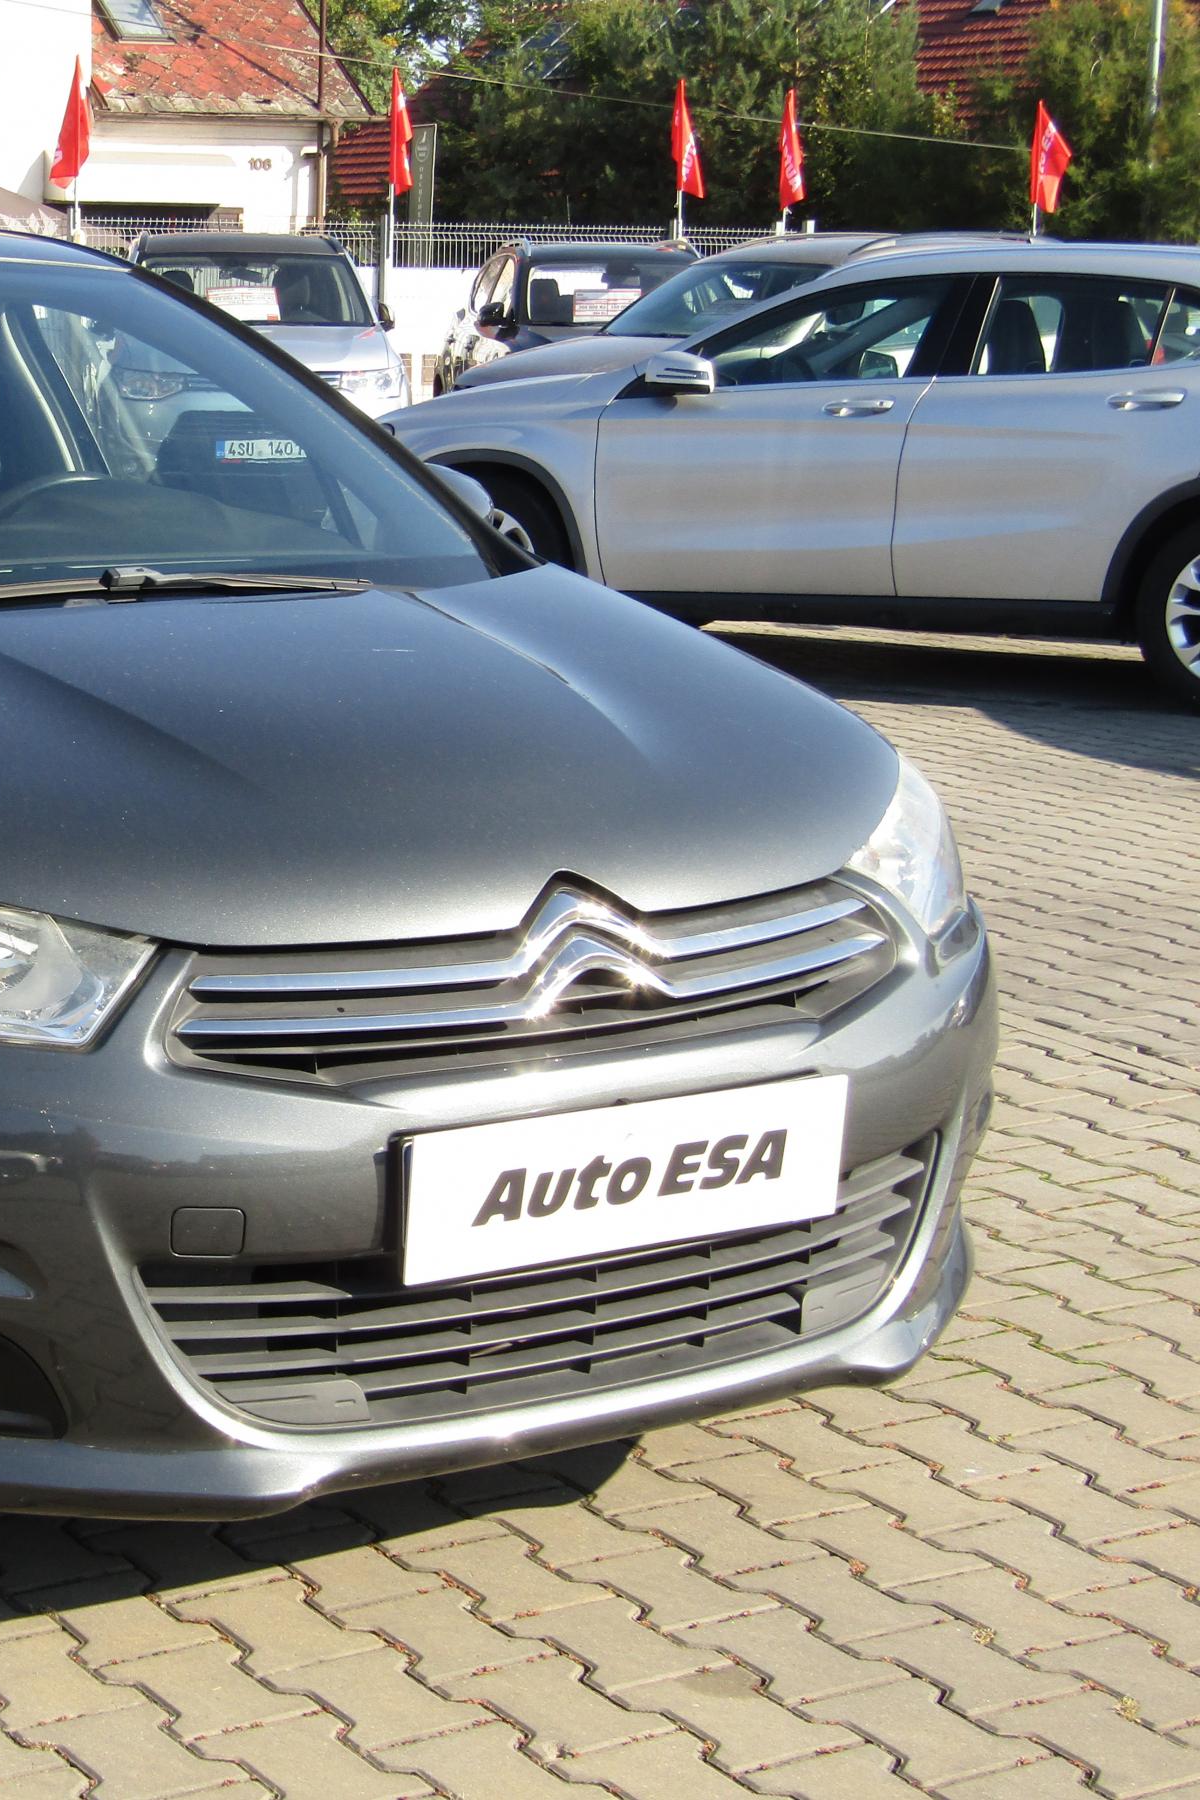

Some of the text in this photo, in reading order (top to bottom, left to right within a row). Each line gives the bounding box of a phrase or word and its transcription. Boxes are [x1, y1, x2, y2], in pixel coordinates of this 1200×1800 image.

[248, 157, 272, 171] 106
[228, 442, 255, 456] 4SU
[471, 1128, 788, 1227] Auto ESA
